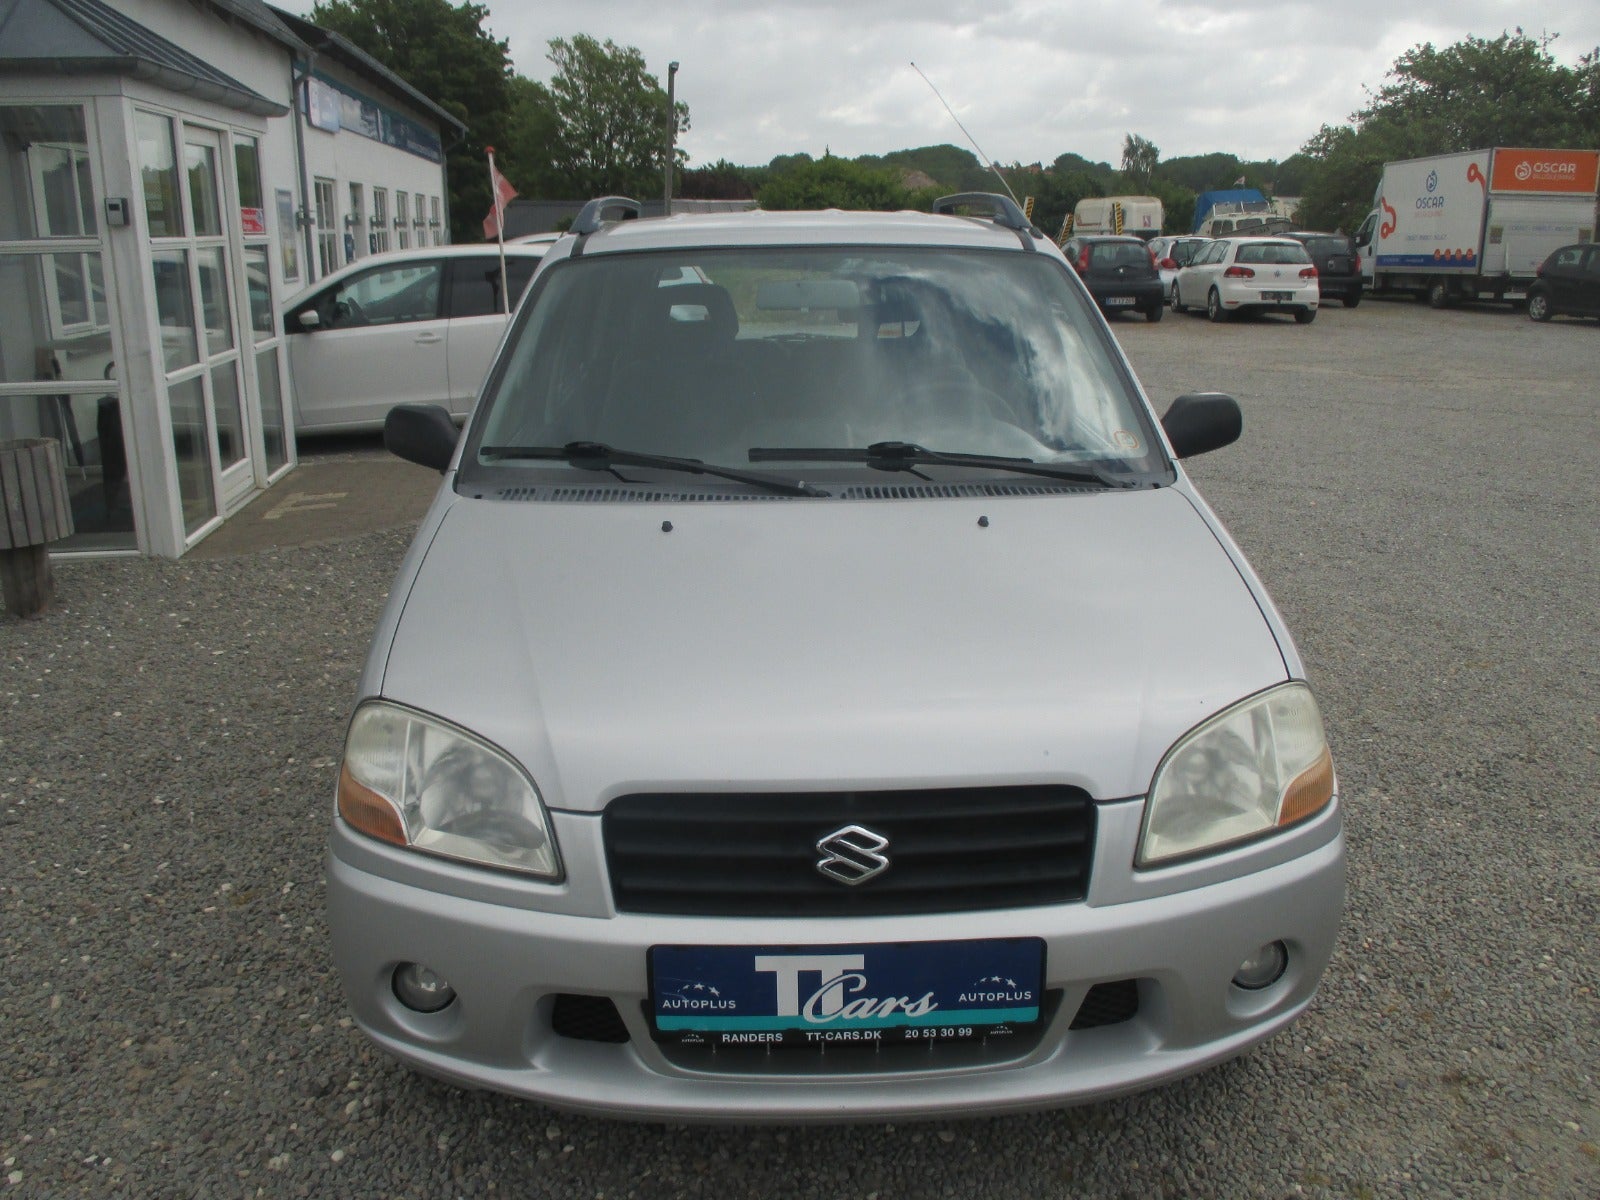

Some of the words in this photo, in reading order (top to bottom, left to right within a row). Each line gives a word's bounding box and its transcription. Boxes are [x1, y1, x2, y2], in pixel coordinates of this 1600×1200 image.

[1533, 162, 1577, 174] OSCAR
[1415, 196, 1445, 209] OSCAR
[802, 973, 939, 1024] Cars
[957, 990, 1033, 1003] AUTOPLUS
[662, 999, 737, 1010] AUTOPLUS
[721, 1032, 784, 1043] RANDERS
[805, 1031, 883, 1041] TT-CARS.DK
[904, 1030, 920, 1039] 20
[922, 1029, 938, 1038] 53
[940, 1029, 955, 1037] 30
[957, 1027, 973, 1037] 99
